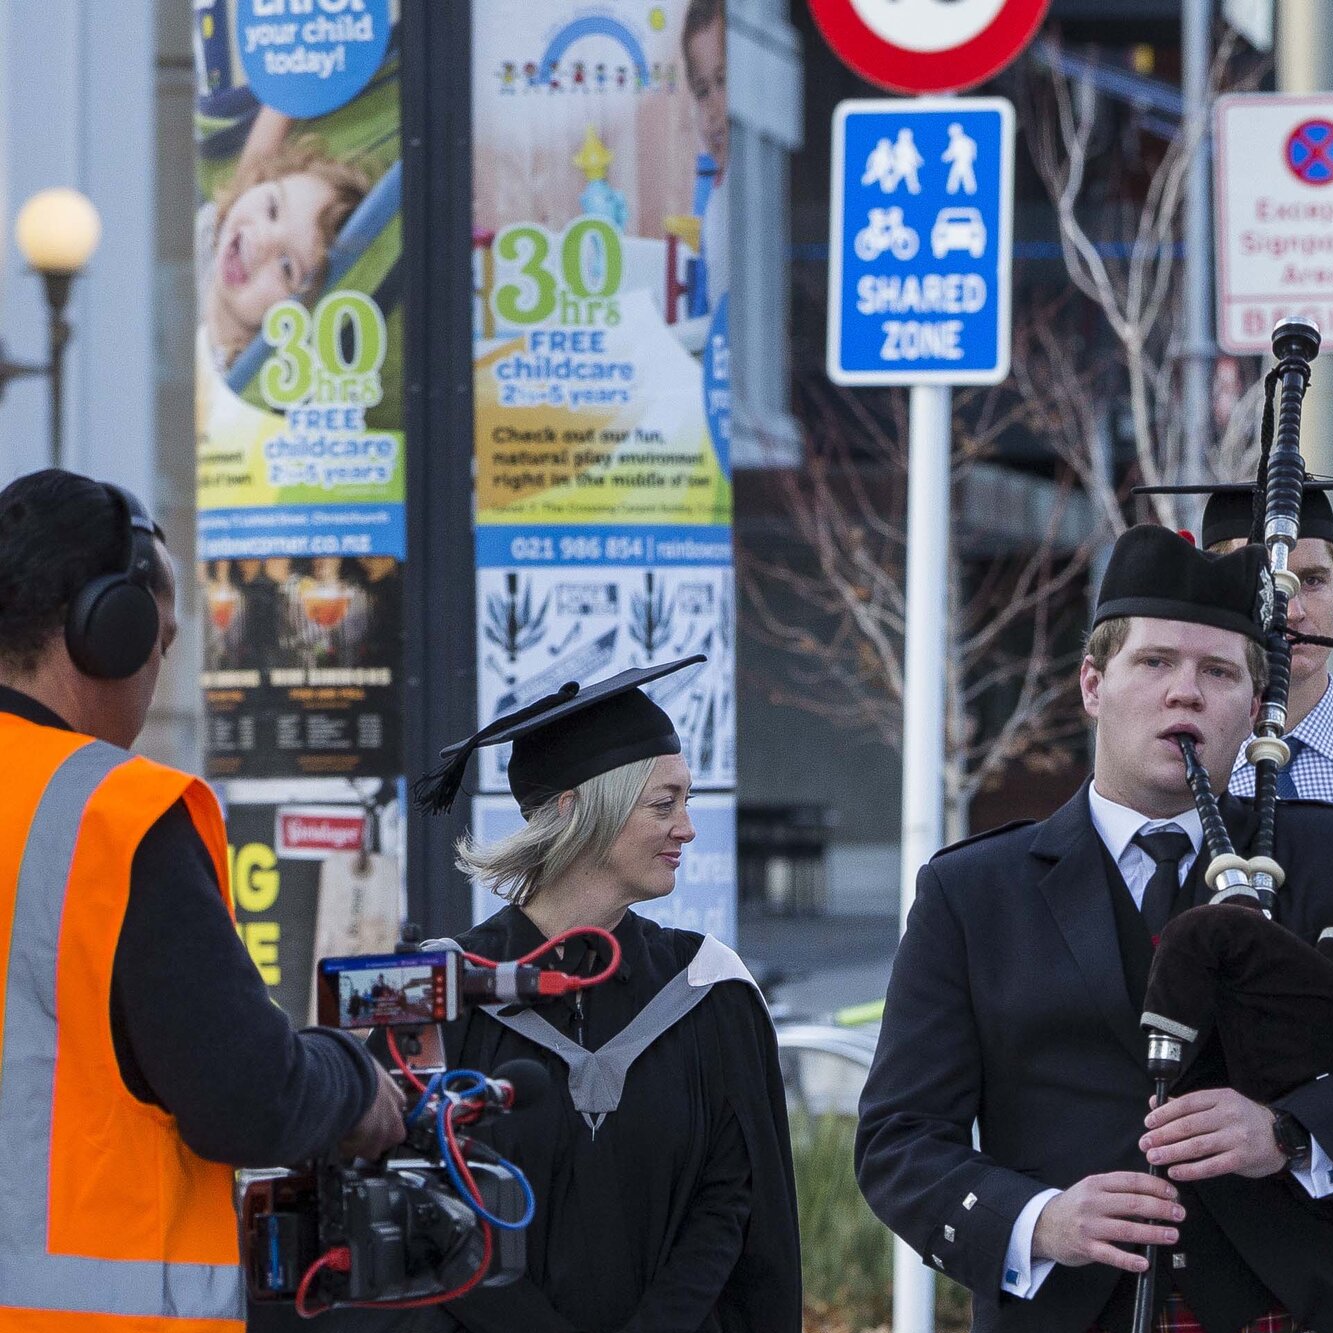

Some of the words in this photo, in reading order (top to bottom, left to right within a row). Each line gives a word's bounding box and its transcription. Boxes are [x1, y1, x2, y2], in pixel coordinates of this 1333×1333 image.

[246, 23, 297, 53] your
[301, 14, 374, 42] child
[265, 45, 346, 79] today!
[496, 219, 622, 325] 30
[857, 273, 987, 315] SHARED
[560, 292, 622, 326] hrs
[265, 295, 382, 406] 30
[530, 331, 606, 353] FREE
[880, 320, 965, 361] ZONE
[497, 356, 634, 380] childcare
[570, 389, 629, 409] years
[290, 408, 360, 431] FREE
[492, 426, 555, 443] Check
[563, 429, 596, 443] out
[600, 430, 630, 443] our
[265, 436, 395, 458] childcare
[492, 451, 567, 466] natural
[573, 451, 611, 469] play
[323, 466, 388, 489] years
[492, 474, 545, 490] right
[551, 474, 570, 487] in
[576, 473, 605, 487] the
[612, 473, 665, 487] middle
[511, 536, 555, 559] 021
